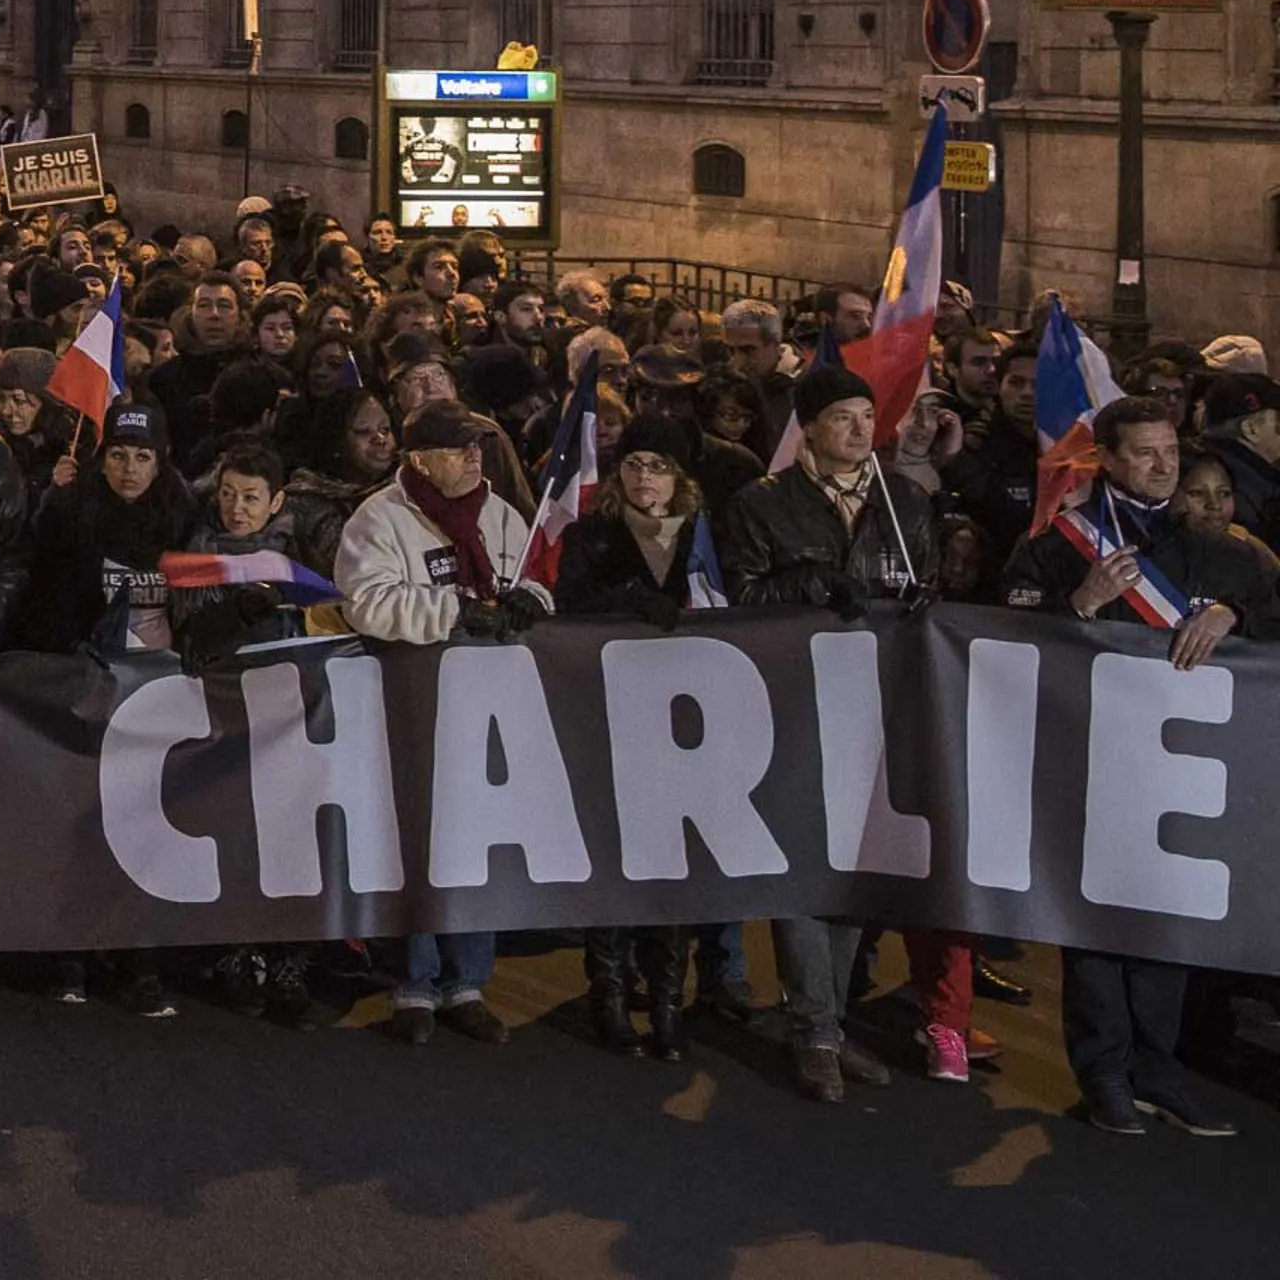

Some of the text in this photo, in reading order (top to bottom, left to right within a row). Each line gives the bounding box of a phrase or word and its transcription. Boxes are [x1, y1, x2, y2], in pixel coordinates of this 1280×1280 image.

[440, 79, 502, 96] Voltaire
[12, 148, 90, 173] JE SUIS
[13, 163, 94, 197] CHARLIE
[117, 412, 148, 421] JE SUIS
[117, 419, 148, 428] CHARLIE
[129, 573, 167, 587] SUIS
[1009, 588, 1041, 598] JE SUIS
[98, 630, 1234, 919] CHARLIE
